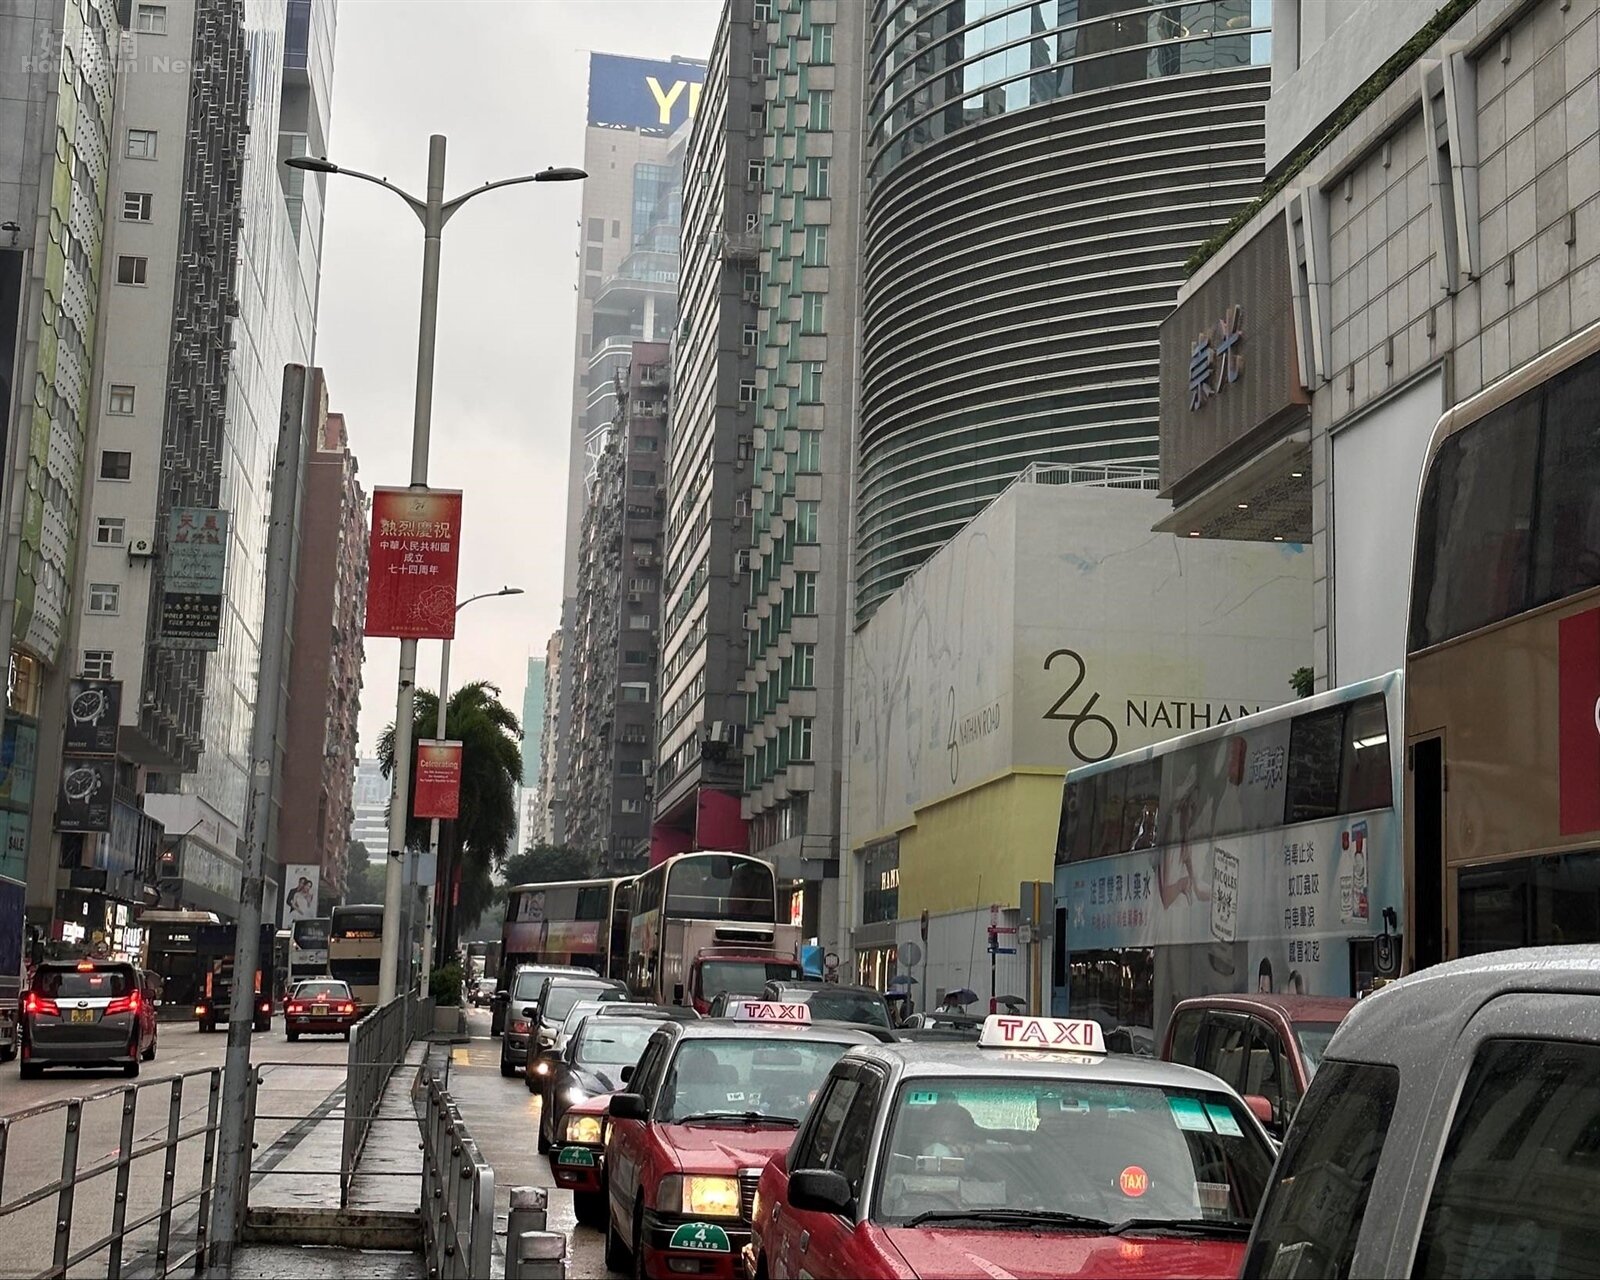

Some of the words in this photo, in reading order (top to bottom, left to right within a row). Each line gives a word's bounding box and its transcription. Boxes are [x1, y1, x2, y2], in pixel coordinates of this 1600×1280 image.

[380, 520, 451, 538] 熱烈慶祝
[380, 540, 450, 552] 中華人民共和國
[403, 553, 424, 563] 成立
[388, 563, 439, 575] 七十四周年
[1041, 648, 1119, 764] 26
[8, 835, 25, 852] SALE
[744, 1002, 804, 1020] TAXI
[997, 1018, 1094, 1047] TAXI
[571, 1149, 580, 1158] 4
[1122, 1173, 1146, 1189] TAXI
[694, 1229, 707, 1242] 4
[681, 1239, 719, 1250] SEATS
